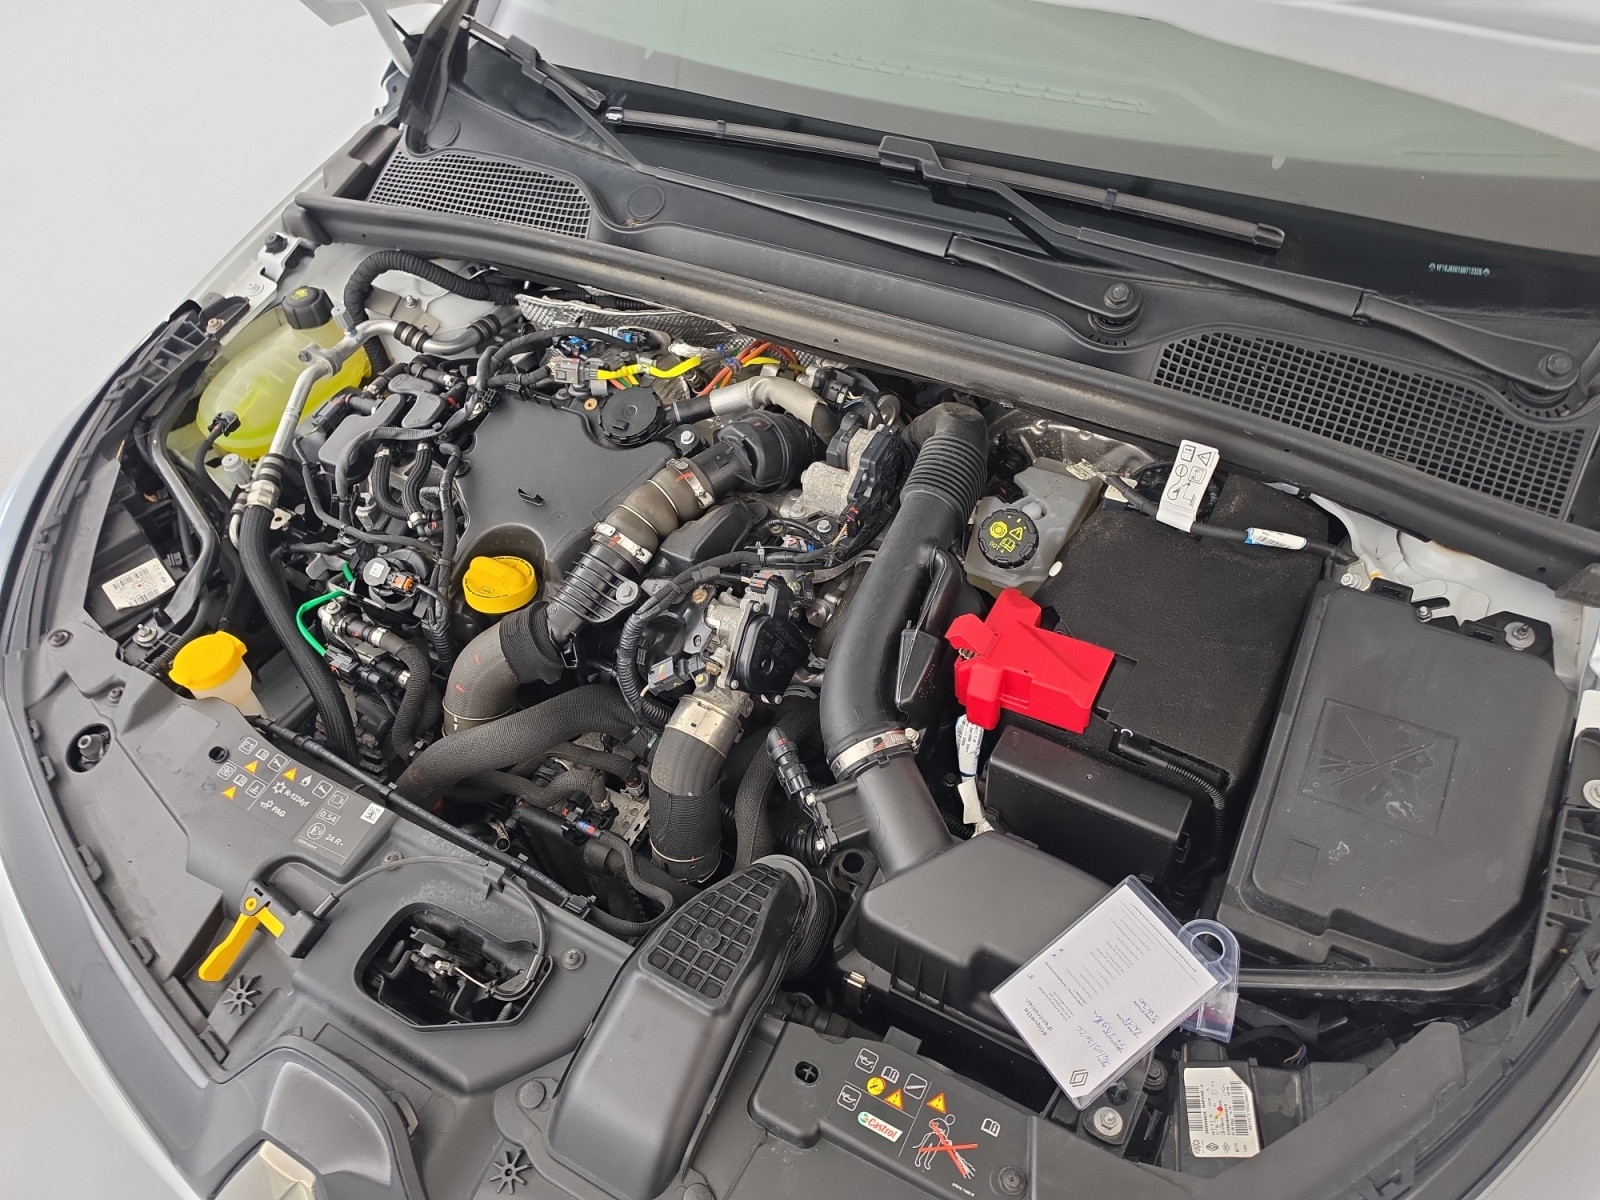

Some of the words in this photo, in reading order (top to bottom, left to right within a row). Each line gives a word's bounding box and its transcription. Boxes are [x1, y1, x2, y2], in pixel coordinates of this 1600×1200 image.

[989, 542, 1001, 550] DOT
[271, 804, 286, 817] PAG
[320, 809, 338, 824] 0.54
[1022, 1006, 1049, 1037] étiquette
[1023, 996, 1054, 1032] d'entretien
[868, 1117, 898, 1139] Castrol
